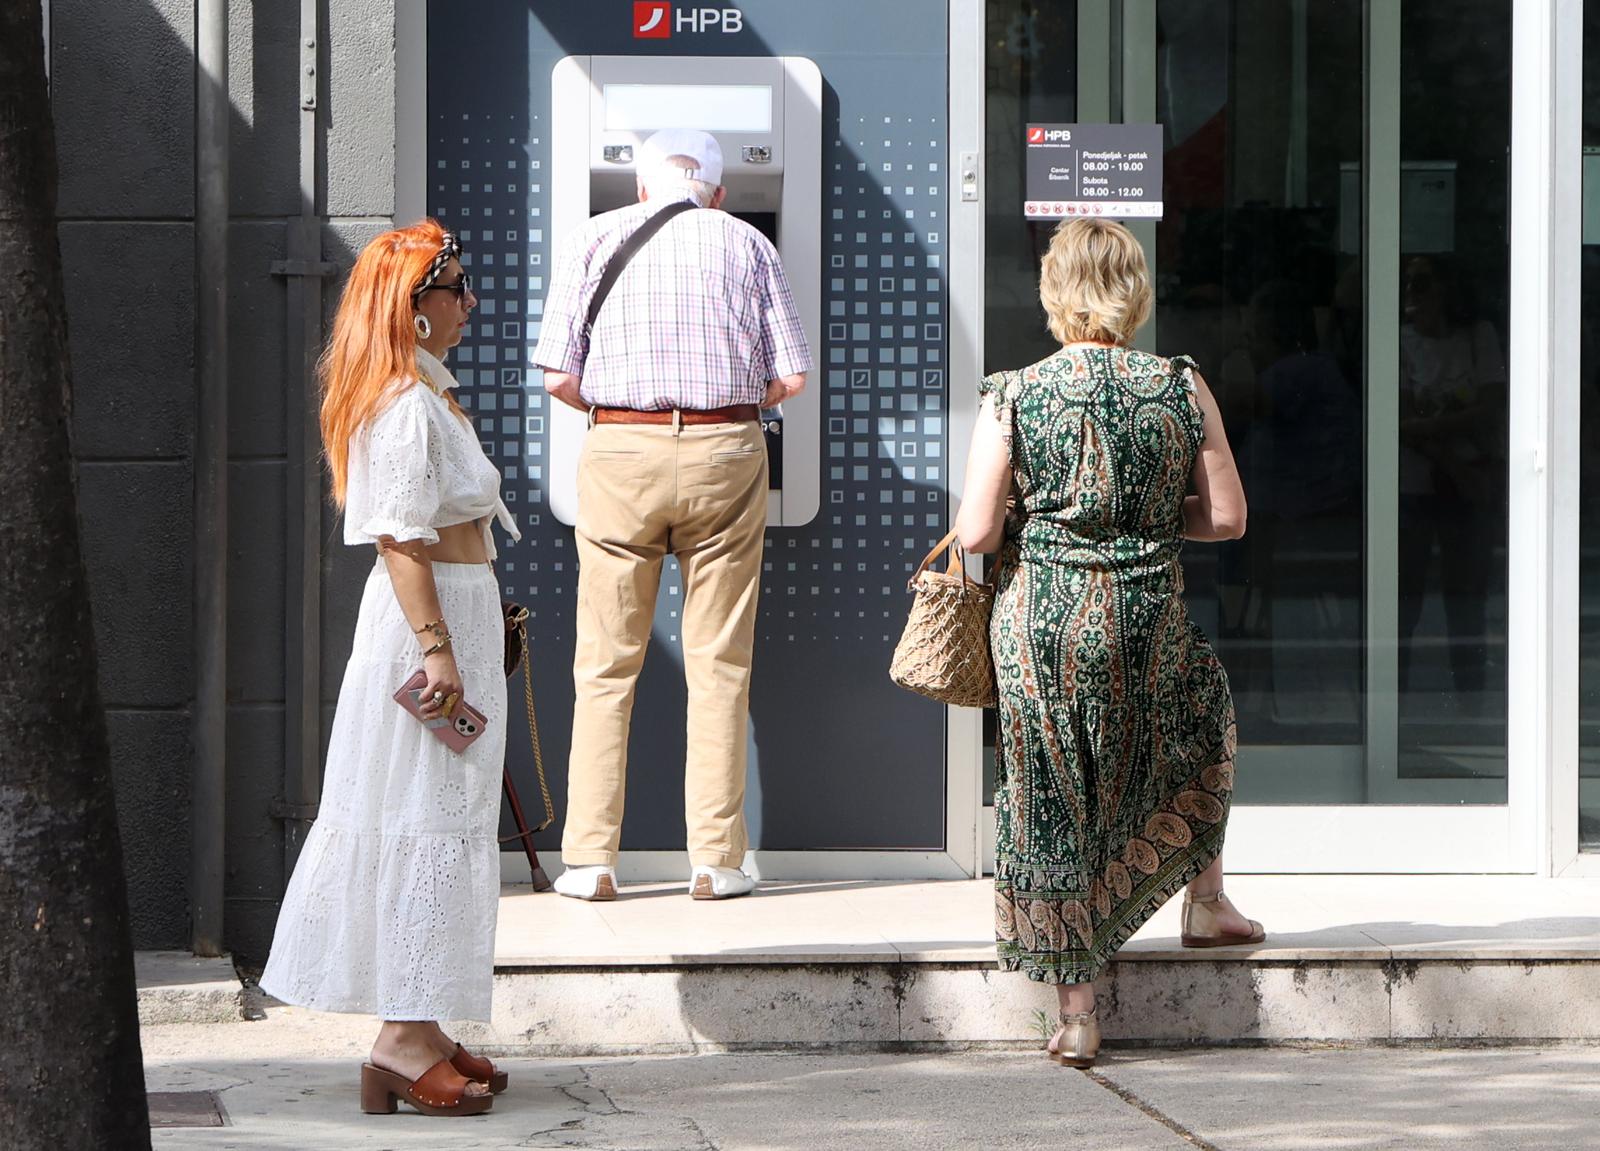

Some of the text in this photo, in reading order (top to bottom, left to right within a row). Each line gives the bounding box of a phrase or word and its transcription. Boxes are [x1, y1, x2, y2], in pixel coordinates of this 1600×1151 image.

[676, 8, 743, 33] HPB
[1044, 130, 1071, 141] HPB
[1082, 151, 1122, 160] Ponedjeljak
[1128, 151, 1148, 160] petak
[1082, 162, 1109, 171] 08.00
[1118, 162, 1143, 171] 19.00
[1082, 176, 1108, 184] Subota
[1082, 187, 1109, 197] 08.00
[1118, 187, 1143, 197] 12.00
